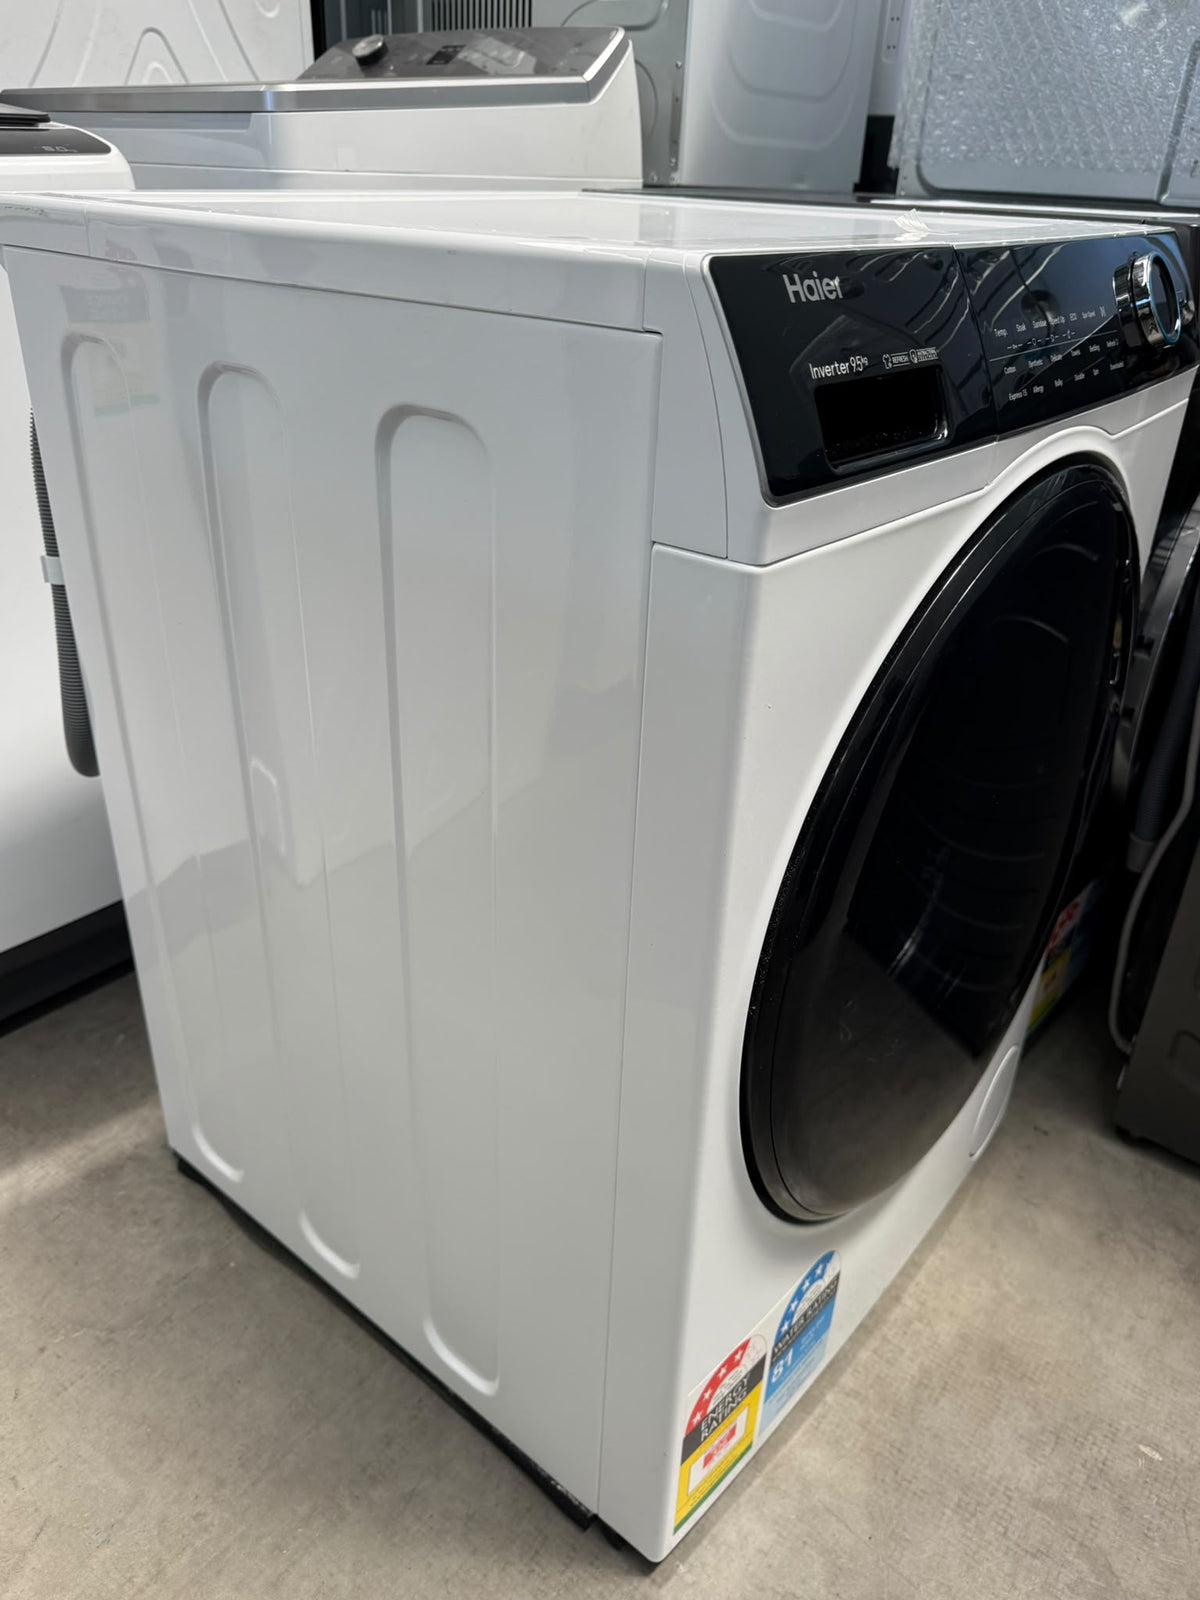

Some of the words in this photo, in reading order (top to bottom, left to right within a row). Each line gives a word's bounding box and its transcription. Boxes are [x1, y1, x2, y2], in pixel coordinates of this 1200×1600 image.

[783, 271, 843, 303] Haier
[809, 361, 850, 380] Inverter
[771, 1347, 793, 1384] 81
[701, 1371, 751, 1431] ENERGY
[701, 1390, 748, 1441] RATING
